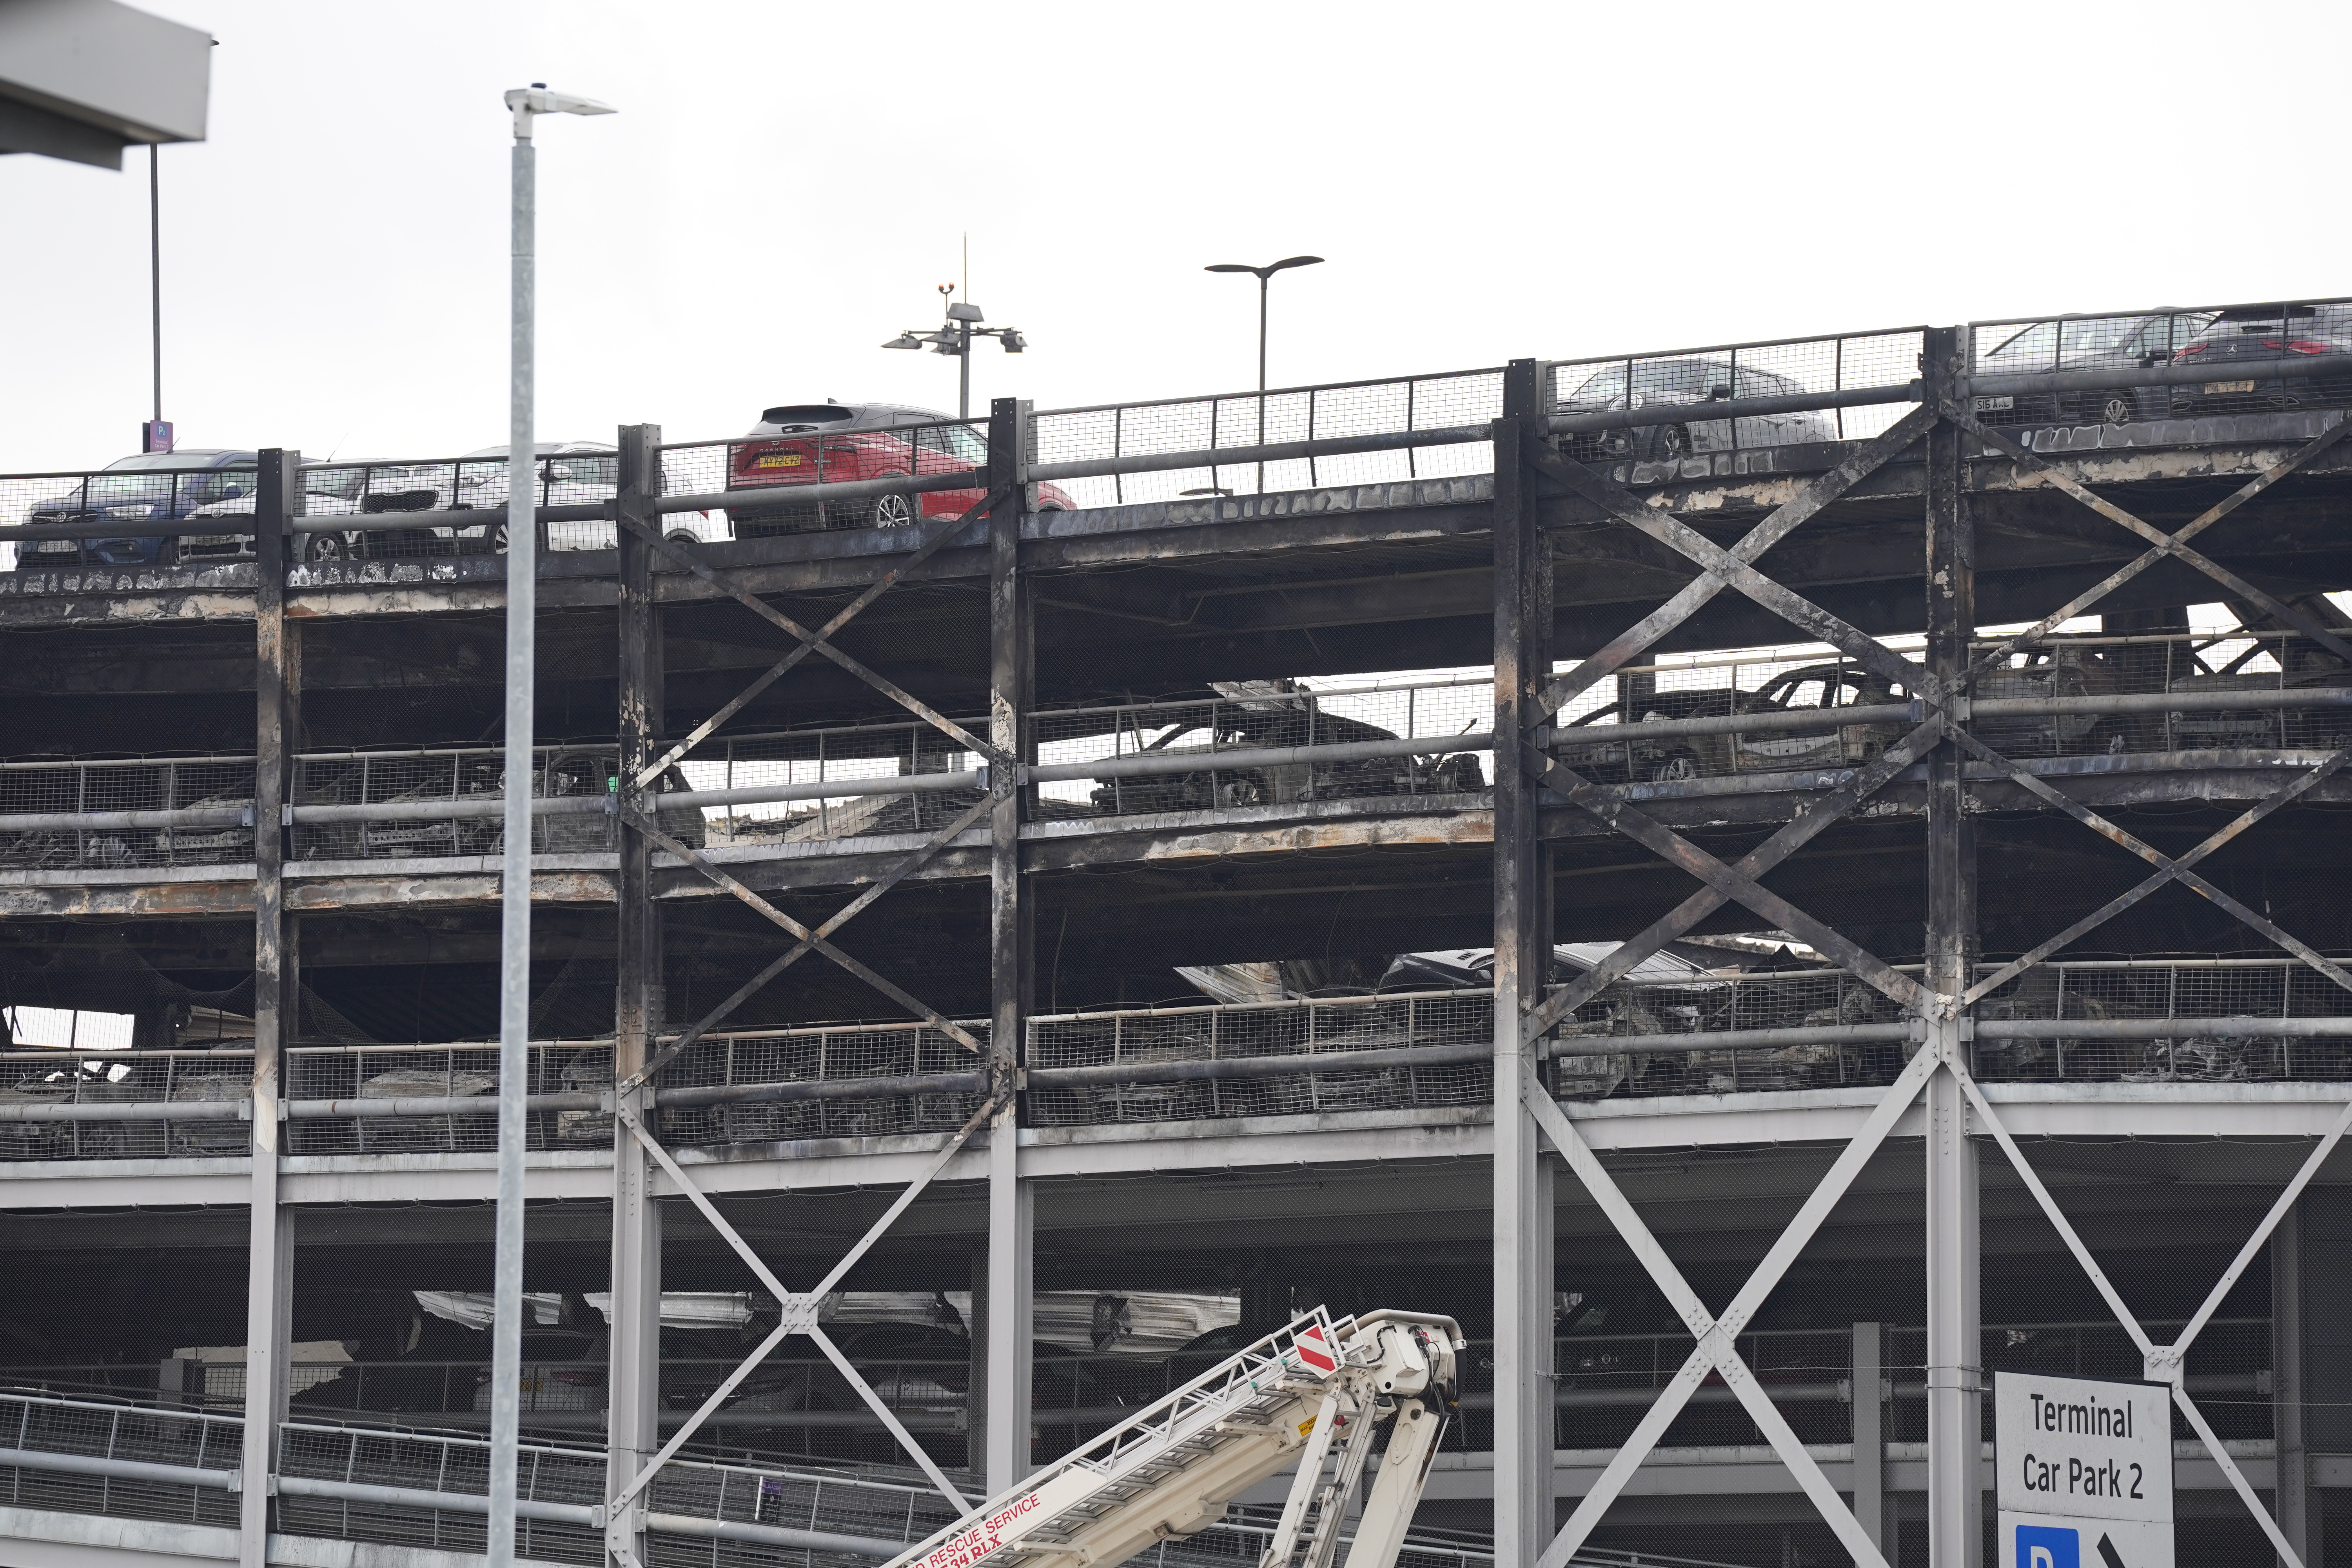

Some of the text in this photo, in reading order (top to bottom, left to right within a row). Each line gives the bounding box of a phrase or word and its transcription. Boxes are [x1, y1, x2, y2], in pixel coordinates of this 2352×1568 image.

[1977, 400, 1990, 409] S16
[158, 426, 165, 436] P2
[2030, 1394, 2132, 1438] Terminal
[2024, 1454, 2143, 1499] Car Park 2
[929, 1494, 1040, 1568] RESCUE SERVICE
[970, 1534, 1002, 1560] RLX
